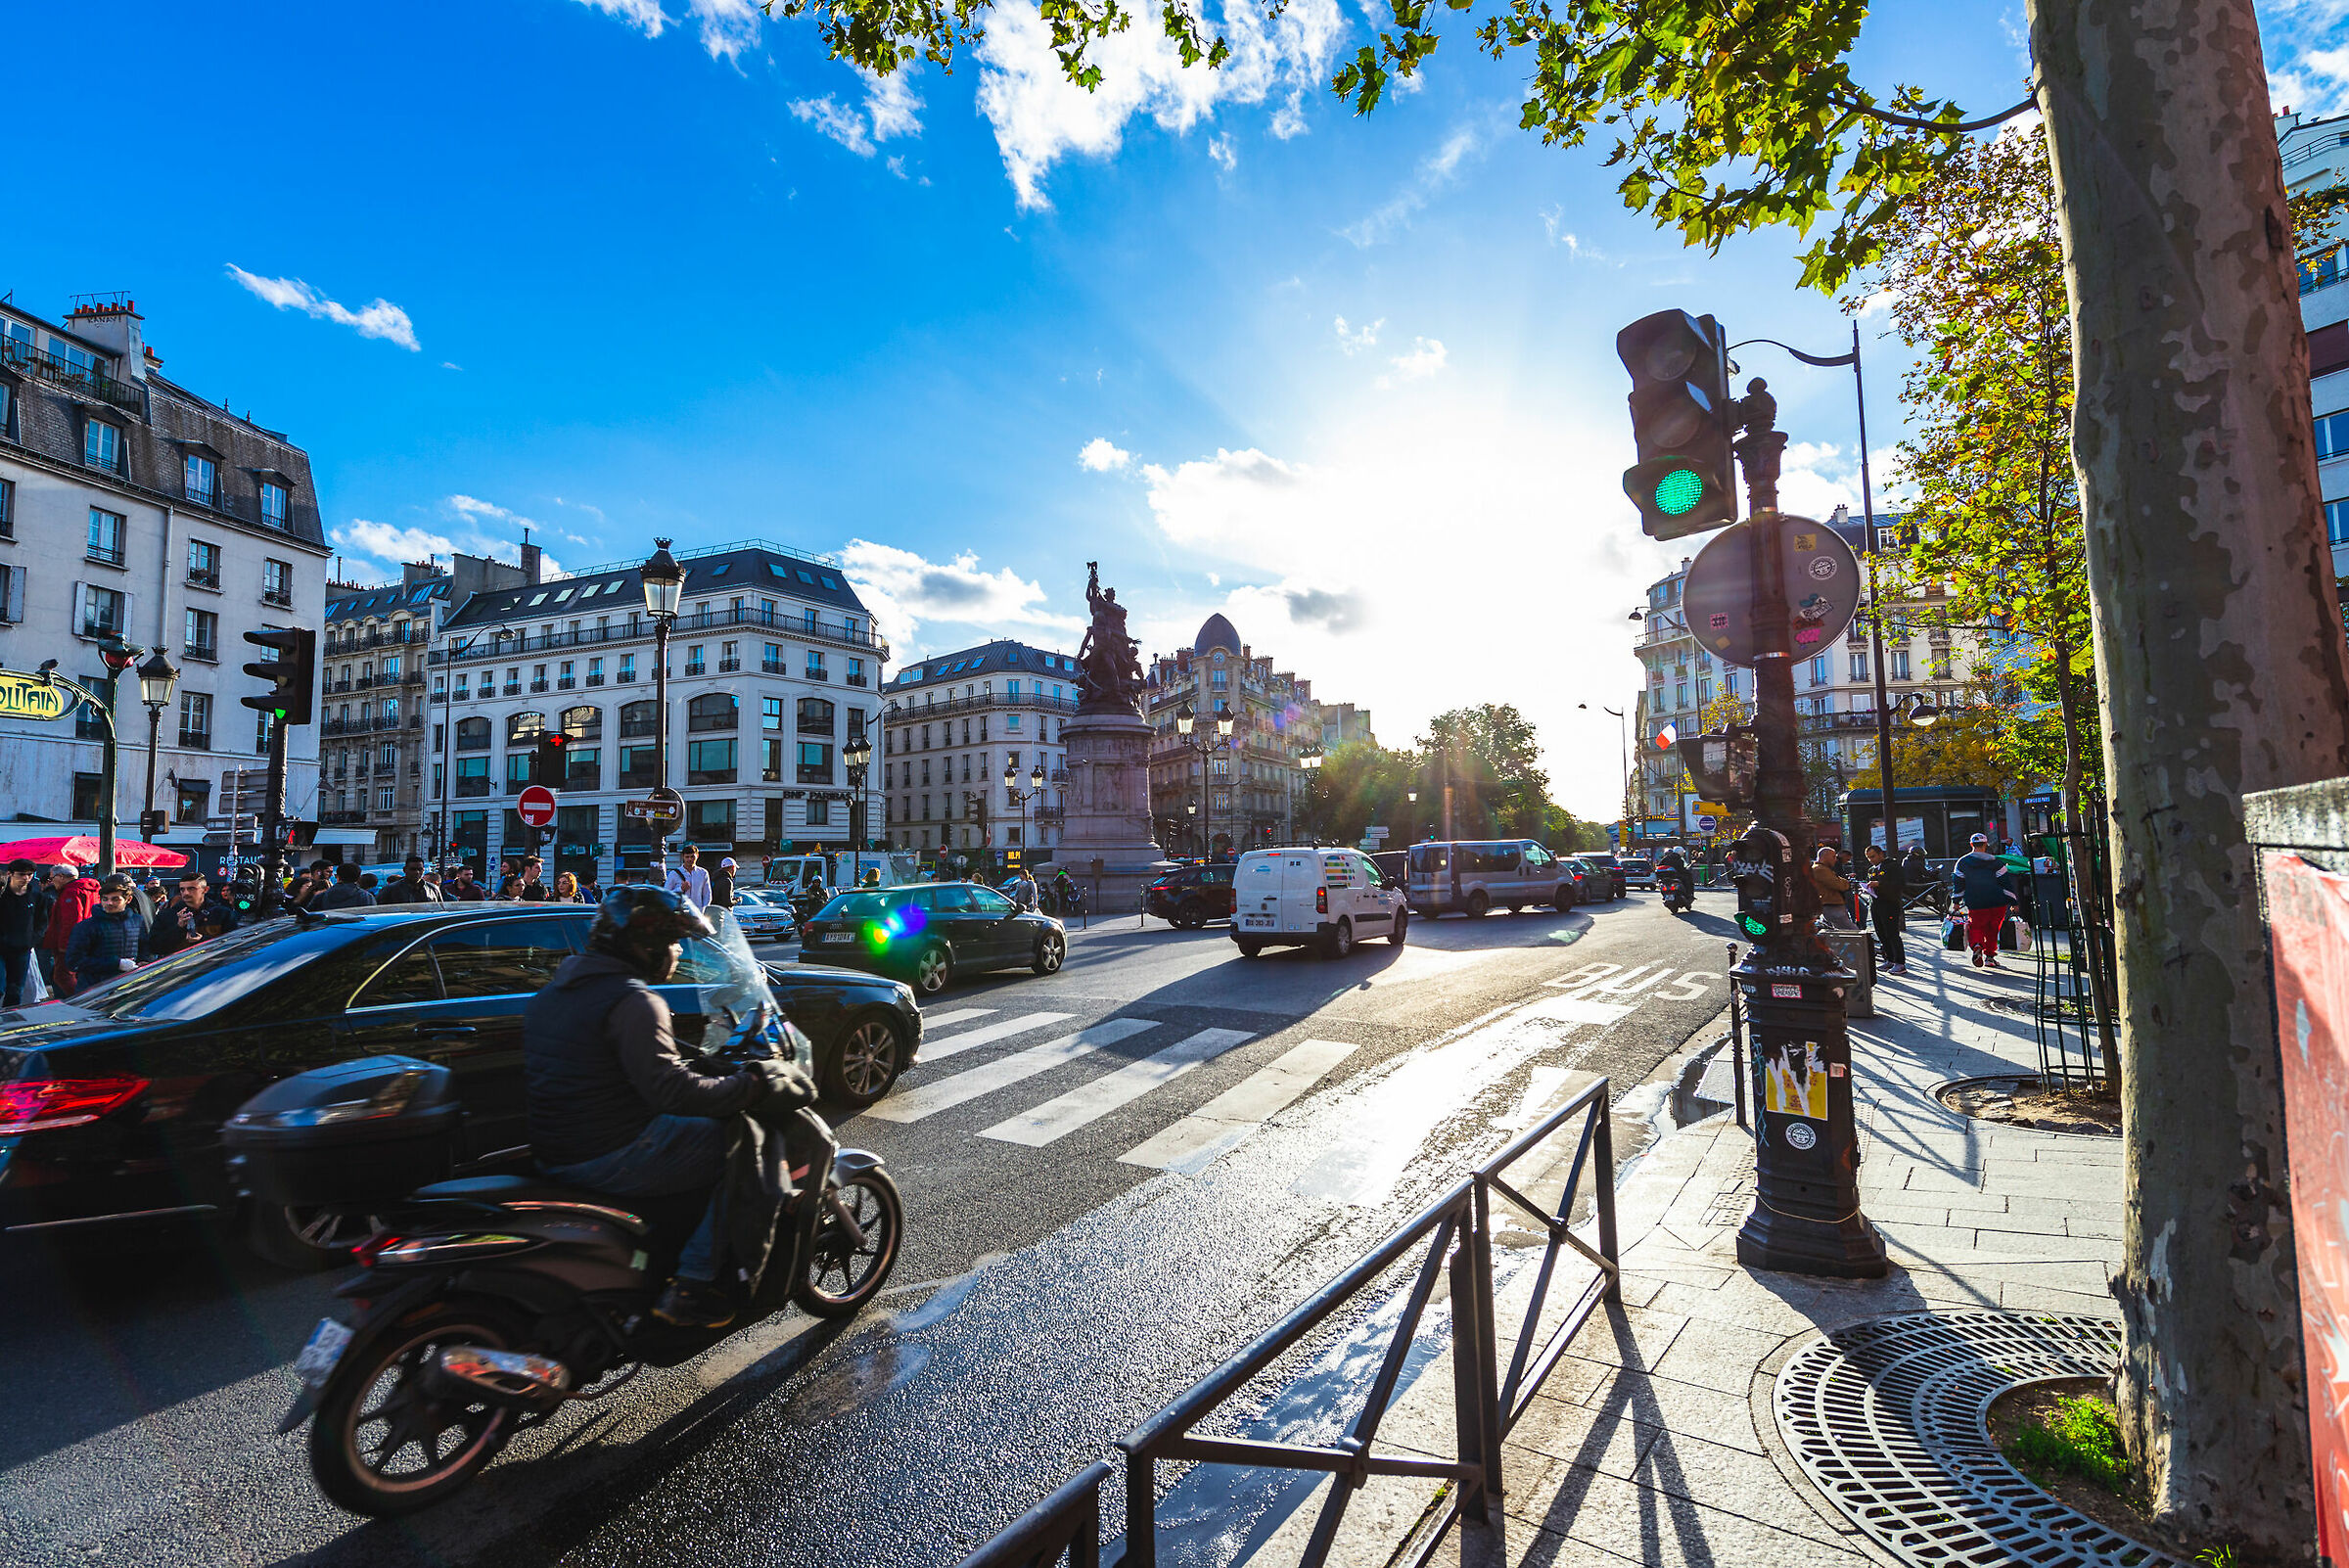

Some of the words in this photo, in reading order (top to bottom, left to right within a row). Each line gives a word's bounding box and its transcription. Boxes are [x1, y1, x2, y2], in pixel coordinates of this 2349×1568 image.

[783, 790, 806, 799] BNP
[219, 854, 262, 865] RETAU
[1540, 959, 1724, 1001] BUS
